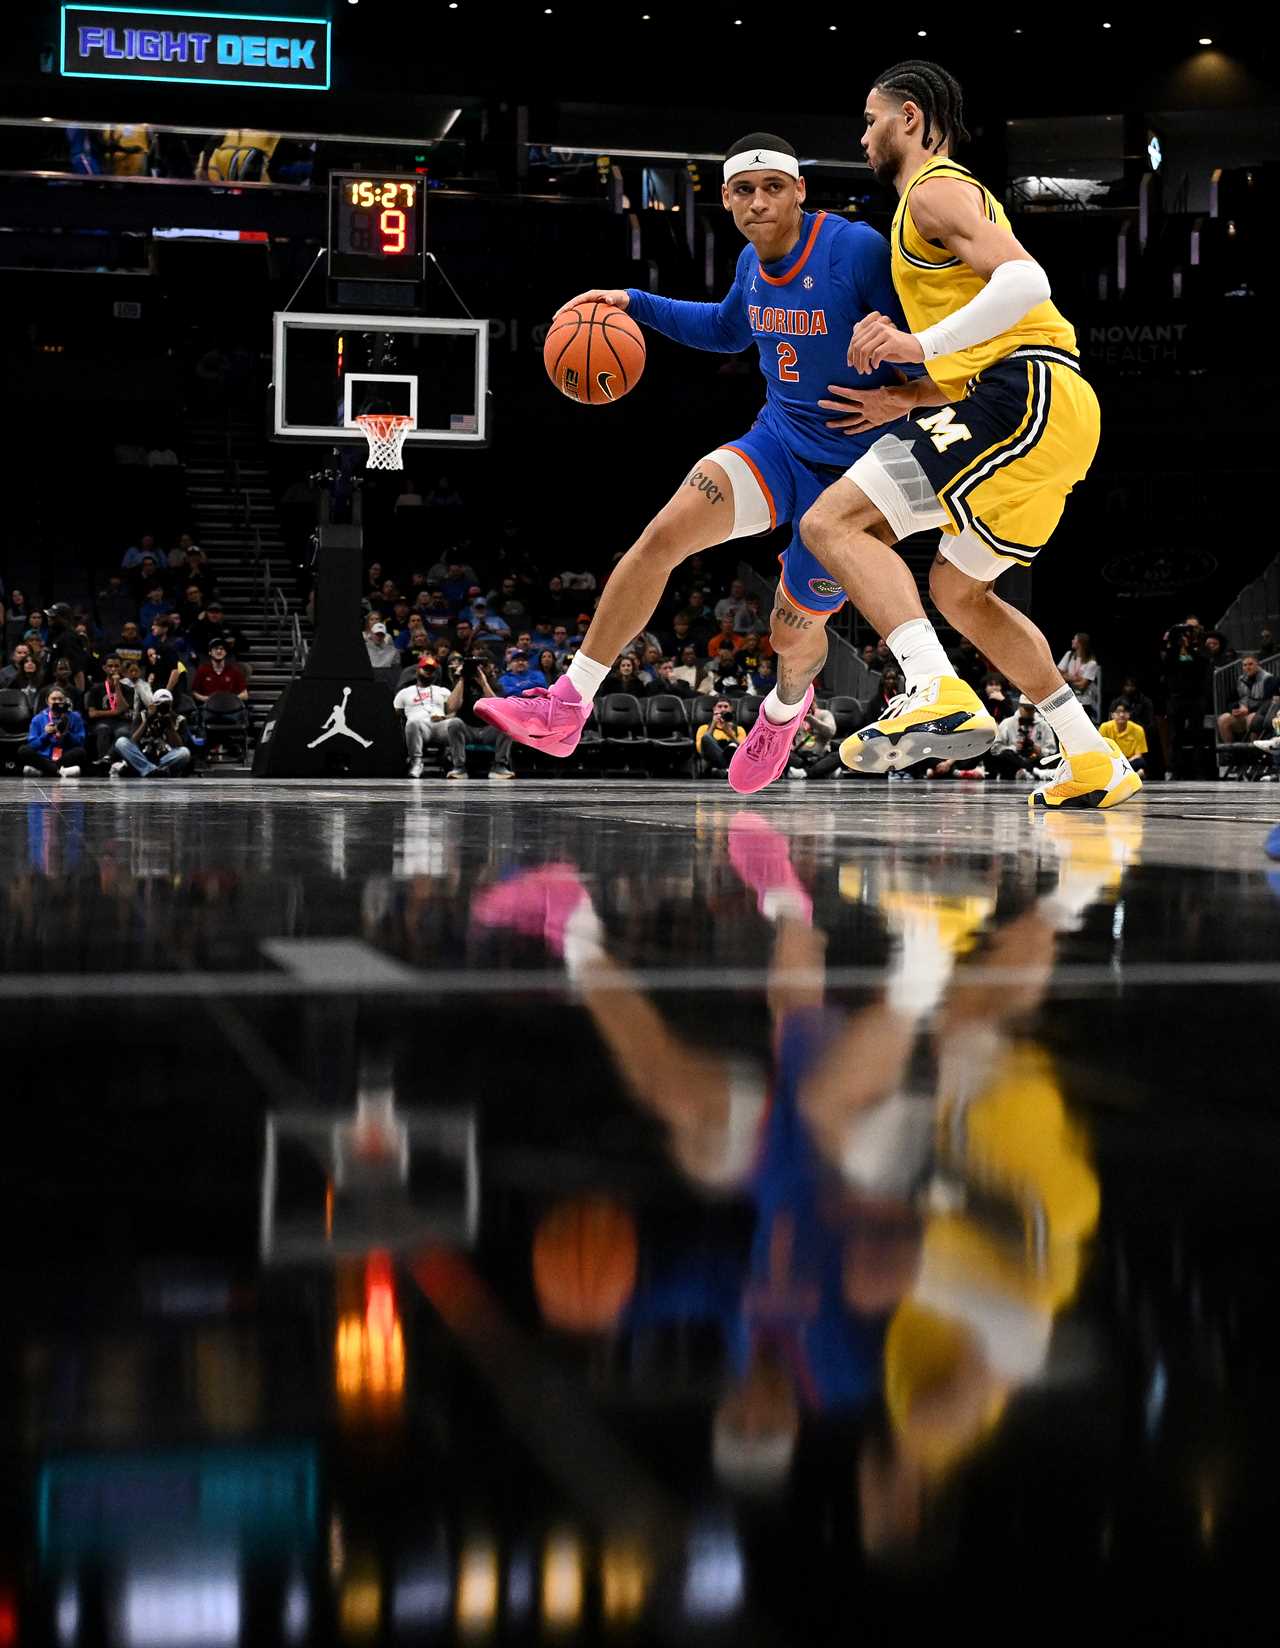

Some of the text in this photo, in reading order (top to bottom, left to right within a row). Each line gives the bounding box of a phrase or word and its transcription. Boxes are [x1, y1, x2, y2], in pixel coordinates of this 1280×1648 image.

[78, 26, 316, 70] FLIGHT DECK
[351, 181, 416, 208] 15:27
[380, 209, 406, 252] 9
[748, 304, 828, 336] FLORIDA
[1089, 323, 1188, 343] NOVANT
[776, 341, 800, 382] 2
[1089, 343, 1177, 362] HEALTH
[915, 406, 973, 453] M
